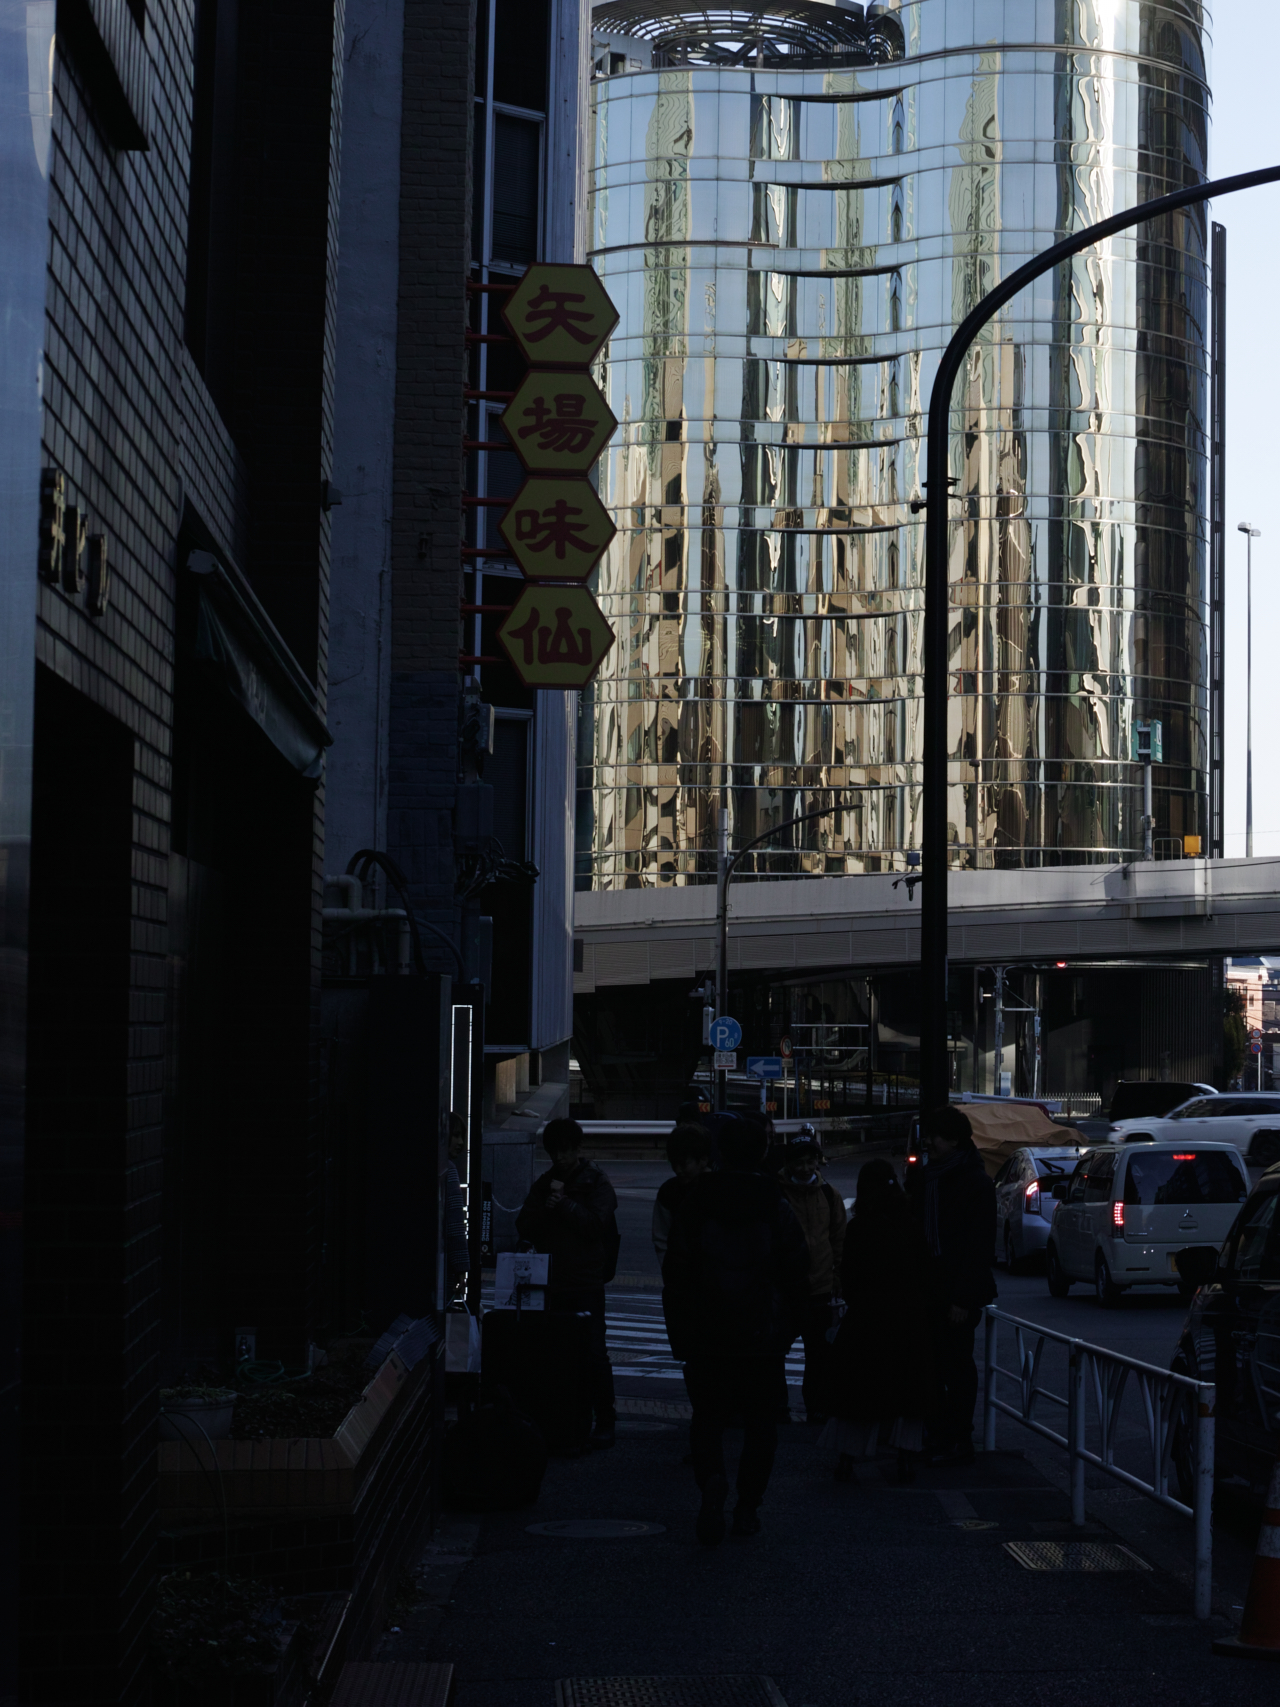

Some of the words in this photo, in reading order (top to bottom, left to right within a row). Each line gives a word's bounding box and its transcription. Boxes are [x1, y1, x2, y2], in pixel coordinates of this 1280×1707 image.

[508, 284, 599, 666] 矢場味仙
[716, 1026, 729, 1048] P
[724, 1037, 735, 1048] 60
[482, 1201, 487, 1211] NO
[486, 1201, 491, 1211] NO
